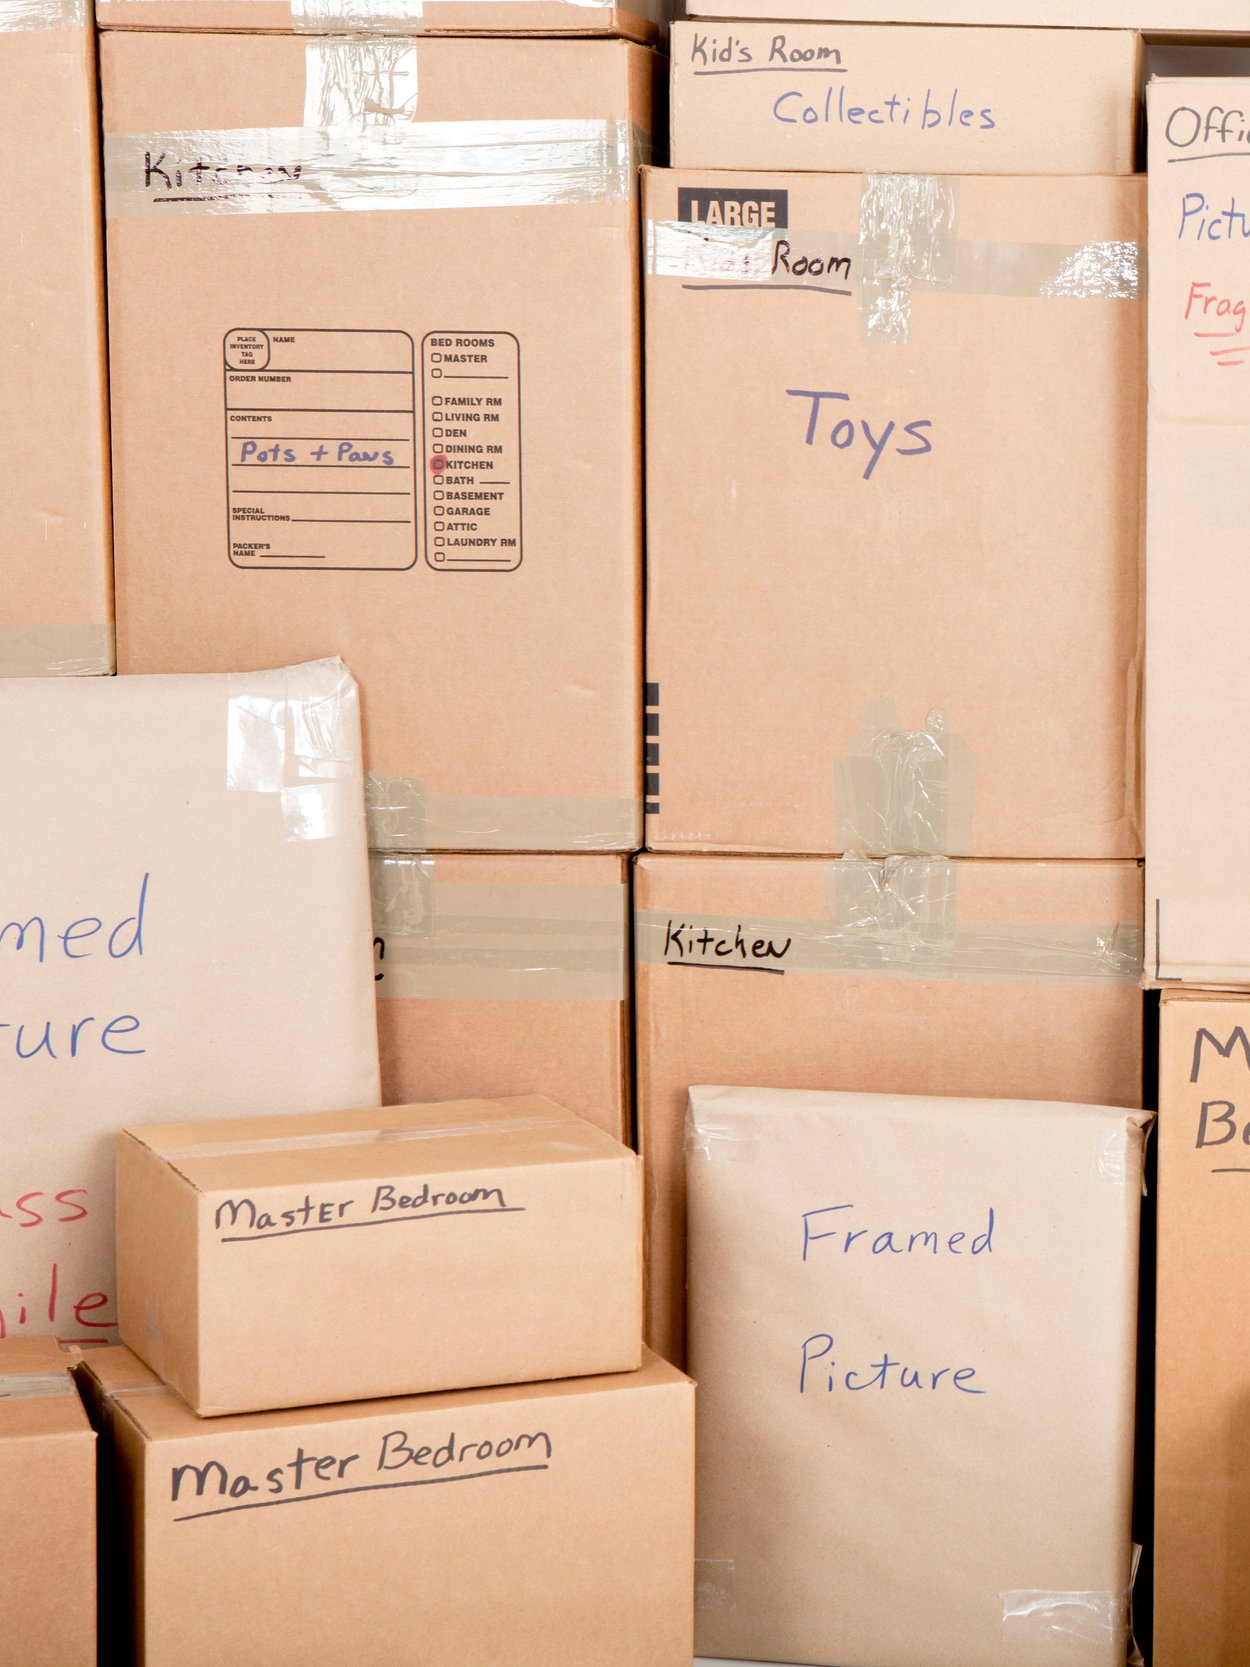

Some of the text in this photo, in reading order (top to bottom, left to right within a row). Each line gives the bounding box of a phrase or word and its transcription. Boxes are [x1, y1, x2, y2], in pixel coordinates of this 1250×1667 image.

[691, 33, 842, 64] Kid's Room
[772, 86, 996, 130] Collectibles
[690, 199, 776, 229] LARGE
[771, 239, 851, 280] Room
[430, 338, 495, 347] BED ROOMS
[443, 354, 488, 363] MASTER
[444, 397, 502, 406] FAMILY RM
[444, 413, 500, 422] LIVING RM
[445, 429, 467, 437] DEN
[785, 388, 933, 481] Toys
[241, 440, 297, 462] Pots
[310, 445, 329, 461] +
[445, 445, 503, 454] DINING RM
[445, 460, 494, 470] KITCHEN
[446, 476, 475, 485] BATH
[446, 491, 505, 501] BASEMENT
[446, 507, 491, 516] GARAGE
[446, 522, 478, 531] ATTIC
[447, 538, 517, 547] LAUNDRY RM
[664, 920, 792, 960] Kitchen
[0, 1014, 146, 1058] ure
[0, 1189, 88, 1228] ss
[371, 1184, 507, 1214] Bedroom
[801, 1204, 995, 1262] Framed
[0, 1263, 118, 1338] ile
[800, 1333, 986, 1394] Picture
[171, 1430, 553, 1502] Master Bedroom
